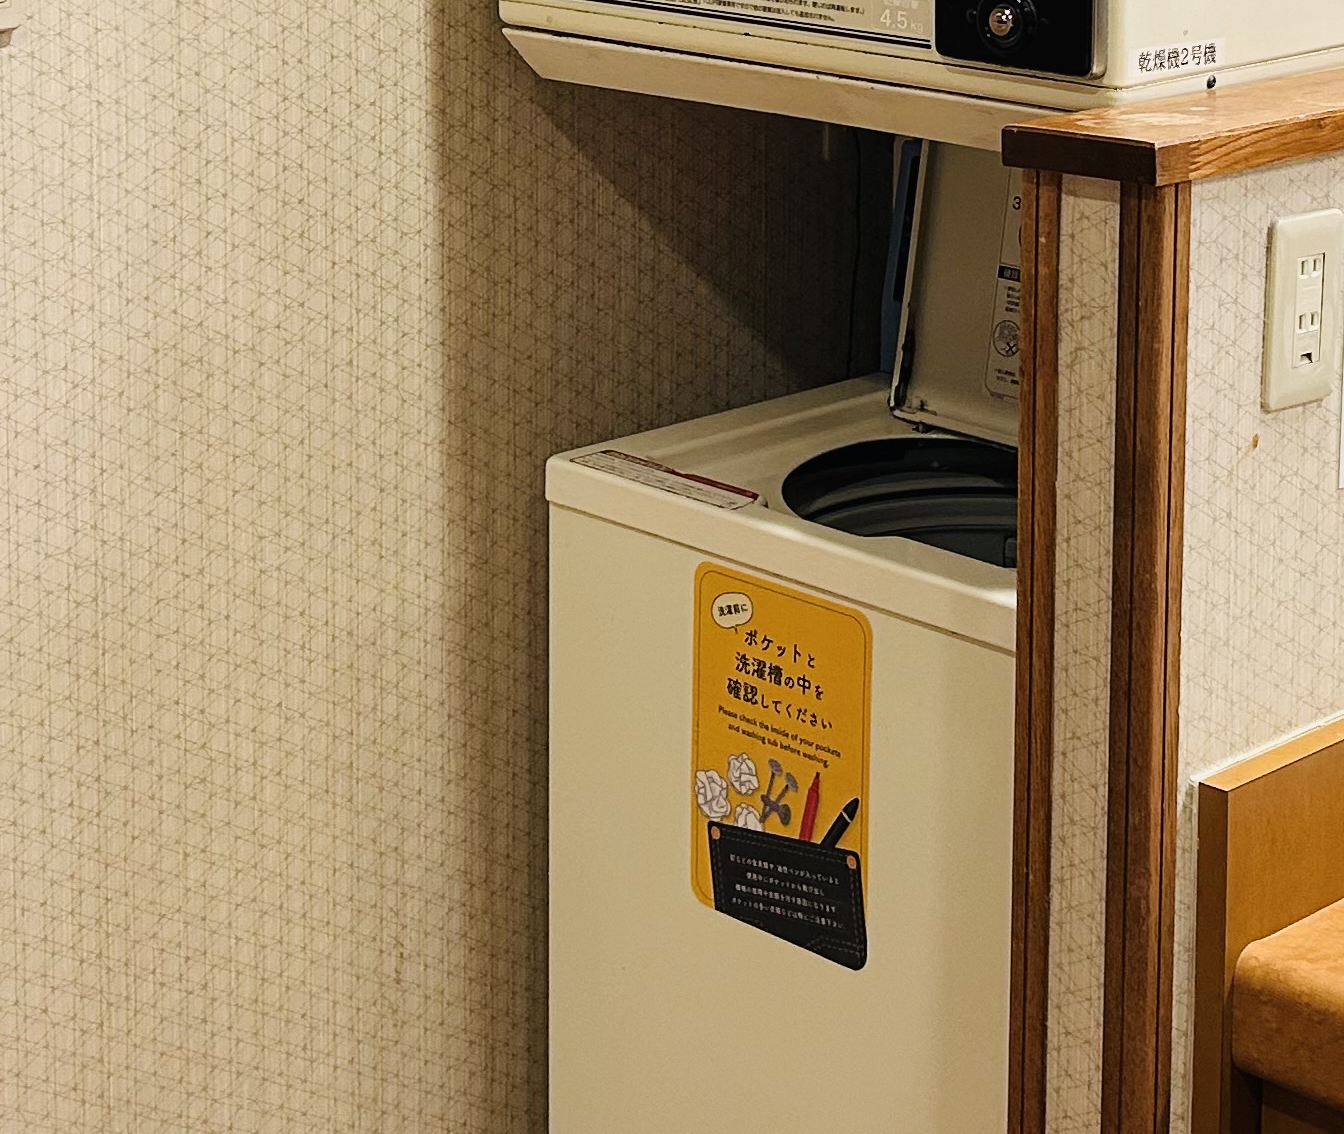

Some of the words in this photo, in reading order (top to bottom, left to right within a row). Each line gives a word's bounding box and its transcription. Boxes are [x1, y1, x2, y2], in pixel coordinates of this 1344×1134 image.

[1138, 42, 1217, 73] 乾燥機2号機
[744, 629, 816, 669] ポケットと
[735, 651, 824, 701] 洗濯槽の中を
[726, 677, 833, 730] 確認してください
[718, 704, 738, 719] Please
[739, 714, 757, 726] check
[759, 721, 769, 731] the
[770, 724, 789, 739] inside
[790, 733, 798, 741] of
[799, 737, 814, 747] your
[815, 743, 841, 758] pockets
[728, 723, 740, 733] and
[741, 728, 766, 744] washing
[779, 742, 801, 756] before
